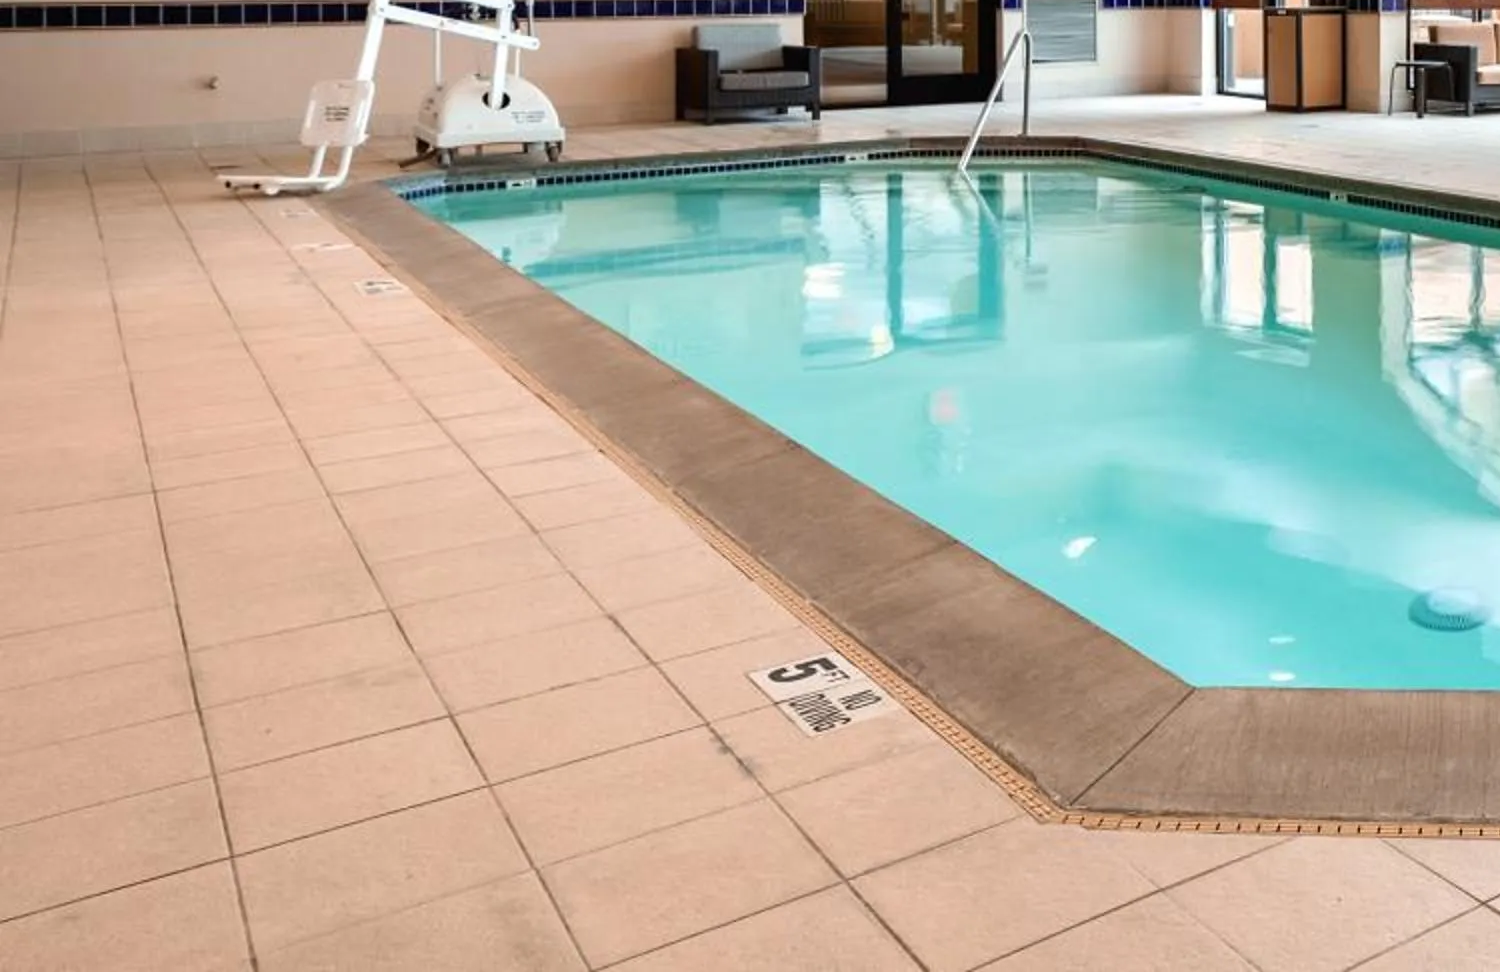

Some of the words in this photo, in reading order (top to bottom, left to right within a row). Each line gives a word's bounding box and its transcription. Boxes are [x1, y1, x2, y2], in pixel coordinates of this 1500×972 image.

[767, 657, 839, 683] 5
[789, 693, 852, 733] DIVING
[838, 690, 882, 711] NO
